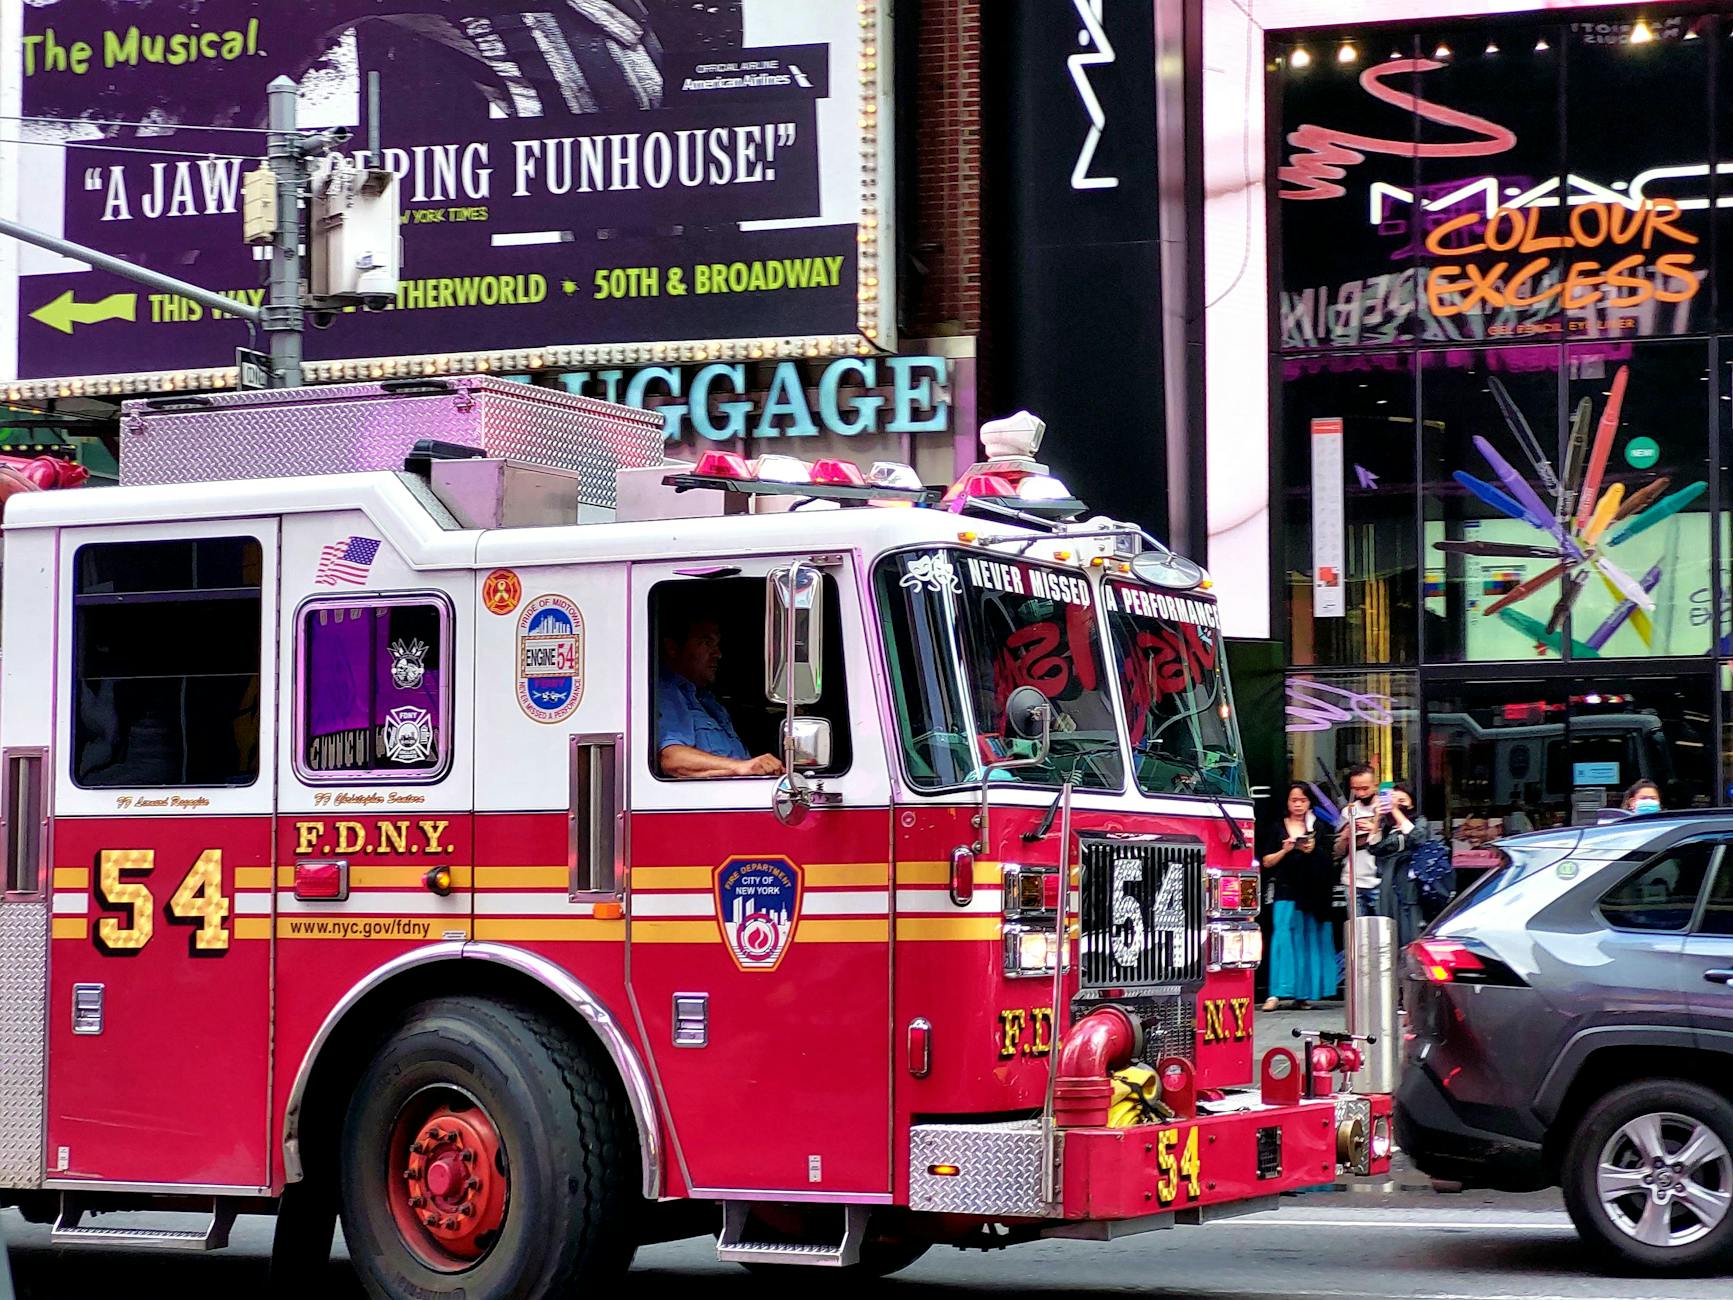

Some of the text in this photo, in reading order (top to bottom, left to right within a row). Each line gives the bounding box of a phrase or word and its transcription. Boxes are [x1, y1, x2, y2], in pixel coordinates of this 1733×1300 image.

[23, 28, 93, 76] The
[682, 73, 791, 91] American Airlines
[411, 209, 446, 224] YORK
[446, 206, 489, 222] TIMES
[1425, 197, 1700, 256] COLOUR
[593, 266, 659, 299] 50TH
[666, 267, 689, 296] &
[694, 255, 845, 294] BROADWAY
[1427, 253, 1700, 317] EXCESS
[967, 557, 1025, 595] NEVER
[1028, 569, 1091, 607] MISSED
[1104, 584, 1119, 613] A
[521, 598, 581, 628] PRIDE OF MIDTOWN
[526, 643, 575, 670] ENGINE 54
[518, 681, 529, 704] NEVER
[526, 703, 547, 719] MISSED
[554, 678, 581, 718] PERFORMANCE
[295, 820, 455, 853] F.D.N.Y.
[724, 863, 792, 890] FIRE DEPARTMENT
[735, 886, 781, 896] NEW YORK
[741, 876, 774, 885] CITY OF
[98, 849, 230, 950] 54
[1111, 857, 1186, 969] 54
[289, 918, 431, 938] www.nyc.gov/fdny
[1156, 1125, 1201, 1203] 54
